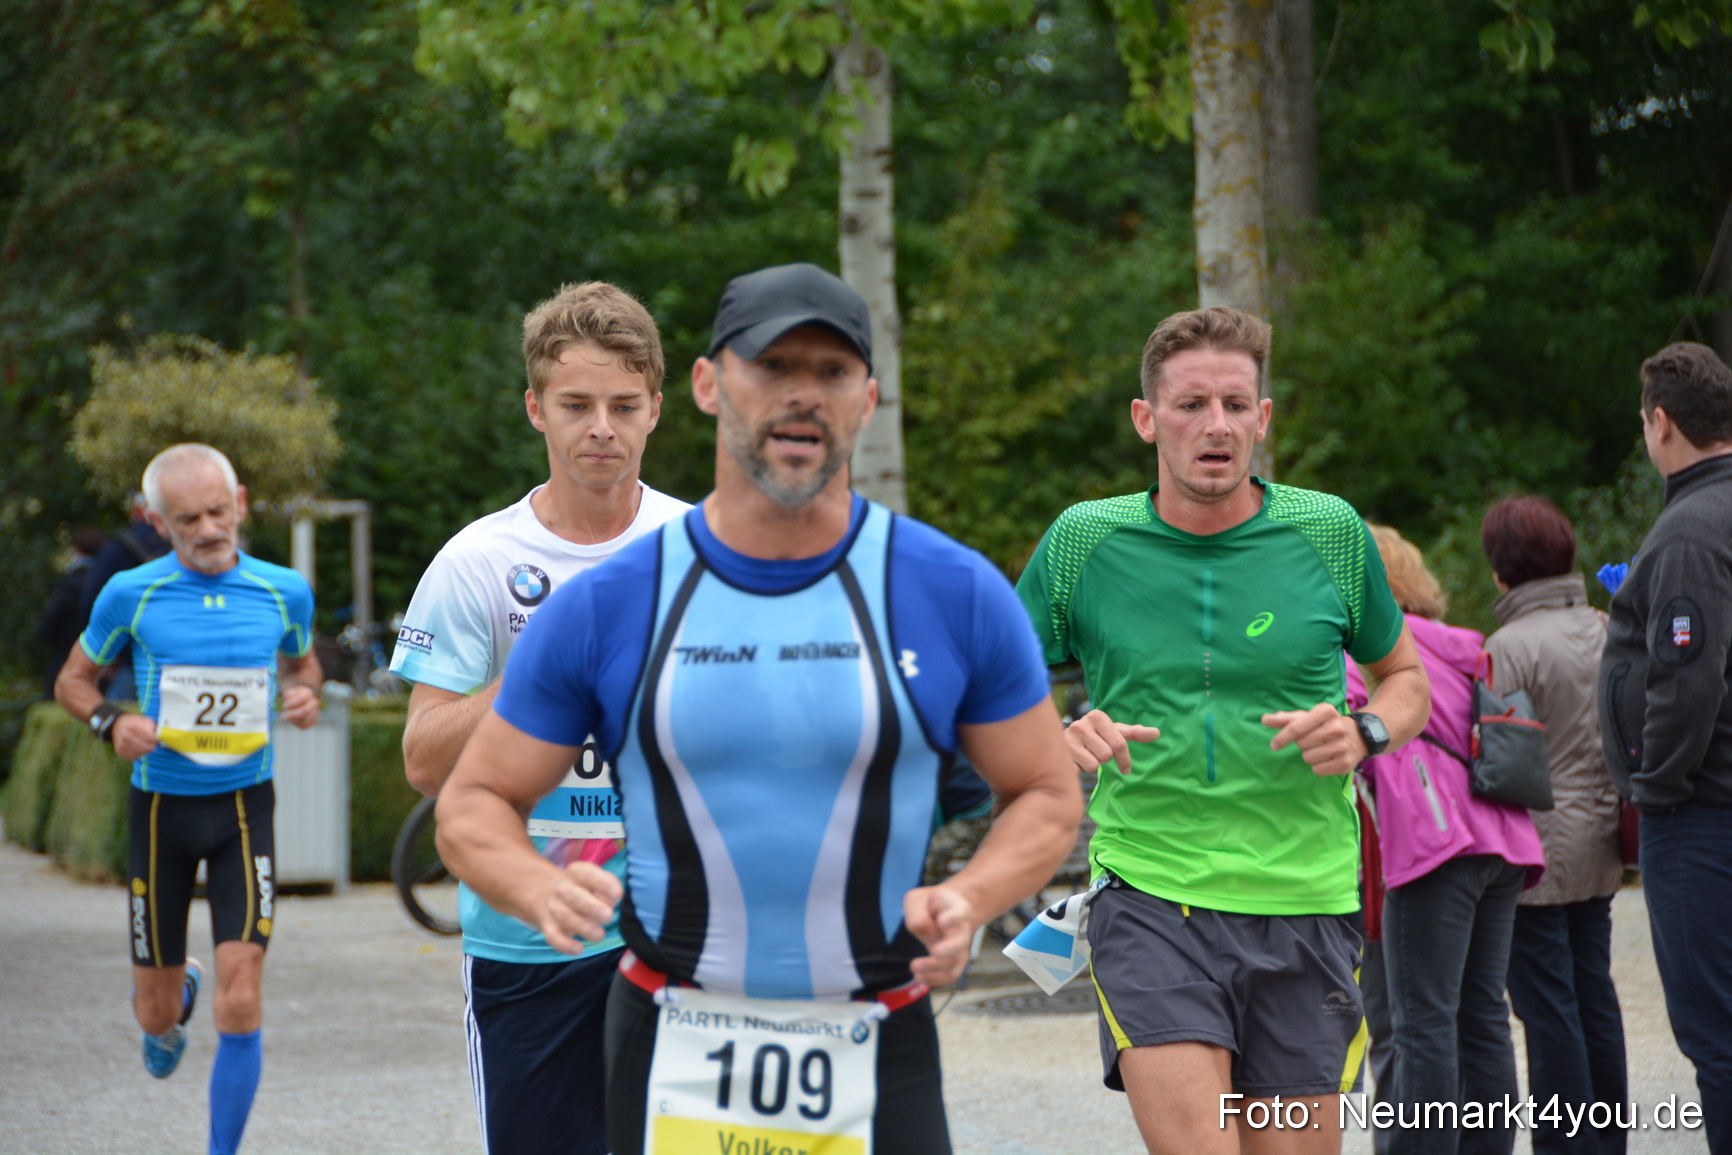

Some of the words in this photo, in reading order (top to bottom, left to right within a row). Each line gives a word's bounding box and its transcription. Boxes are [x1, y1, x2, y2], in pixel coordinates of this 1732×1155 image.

[509, 565, 546, 579] BMW
[195, 692, 238, 726] 22
[665, 1007, 738, 1029] PARTL
[743, 1016, 845, 1039] Neumarkt
[706, 1039, 833, 1121] 109
